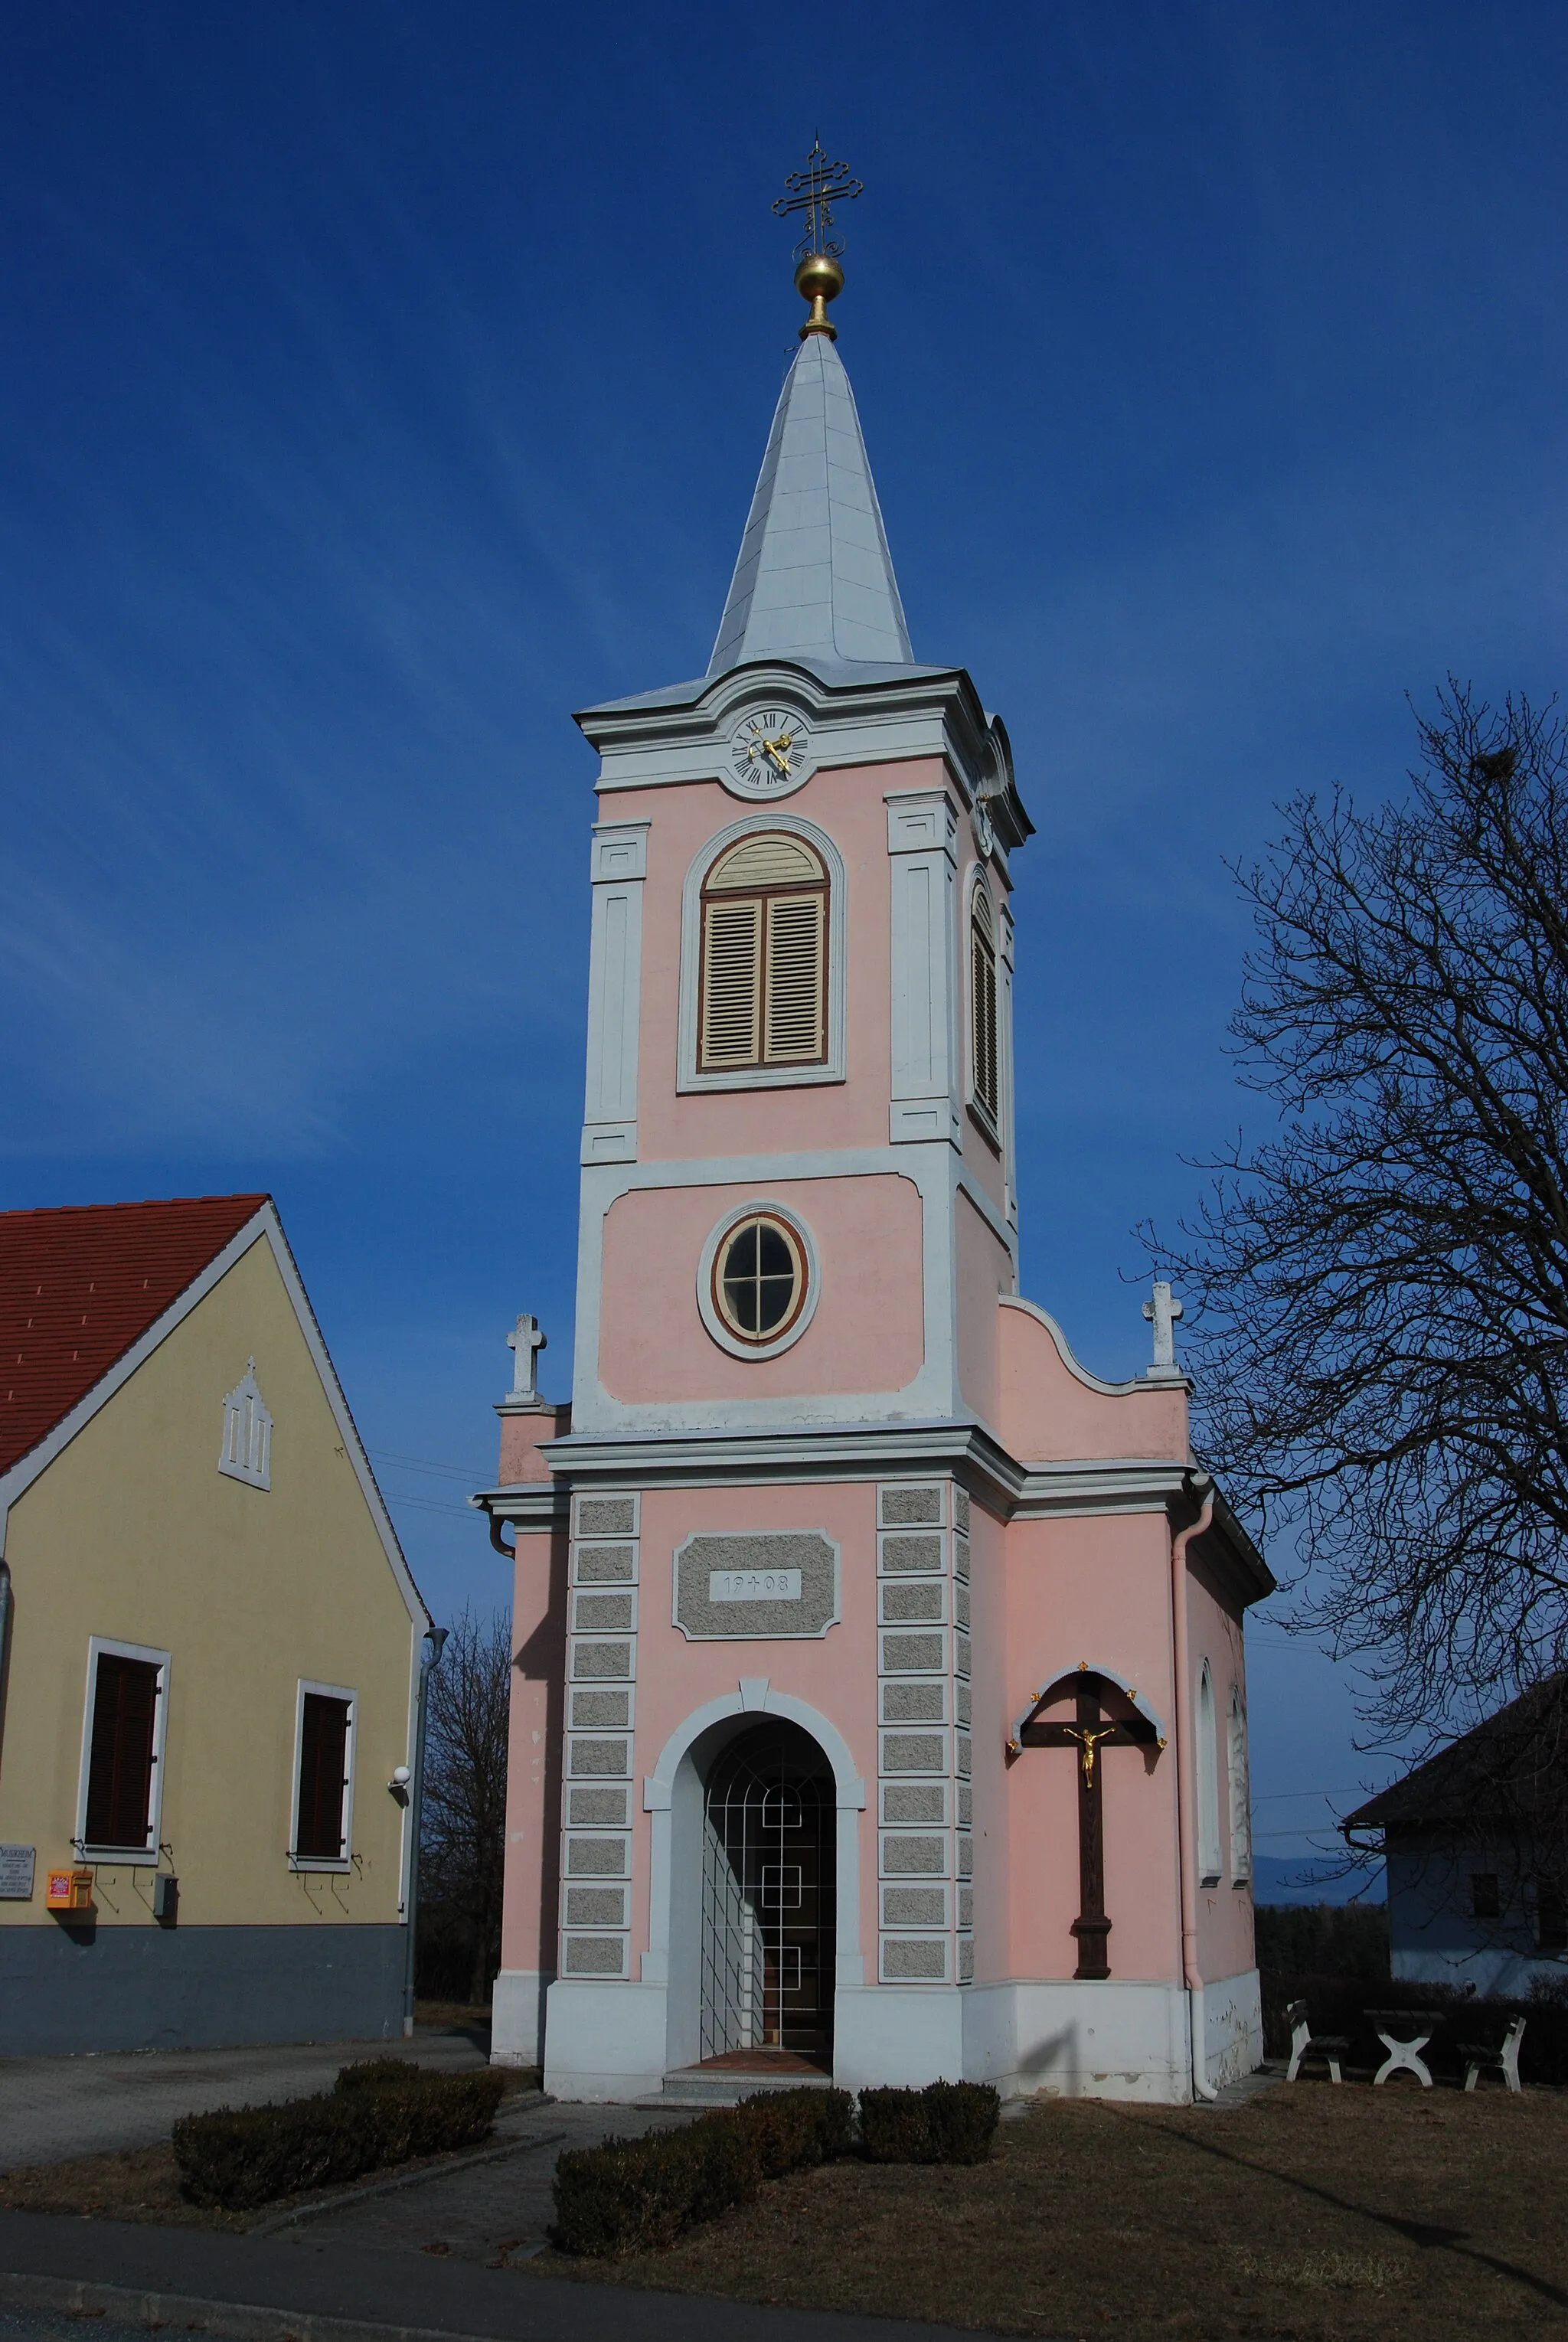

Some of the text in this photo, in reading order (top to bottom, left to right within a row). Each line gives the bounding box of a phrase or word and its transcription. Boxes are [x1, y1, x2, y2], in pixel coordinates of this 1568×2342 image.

[763, 714, 776, 729] XII
[789, 725, 803, 737] II
[736, 733, 750, 743] X
[792, 740, 808, 750] III
[732, 746, 747, 756] IX
[747, 768, 762, 785] VII
